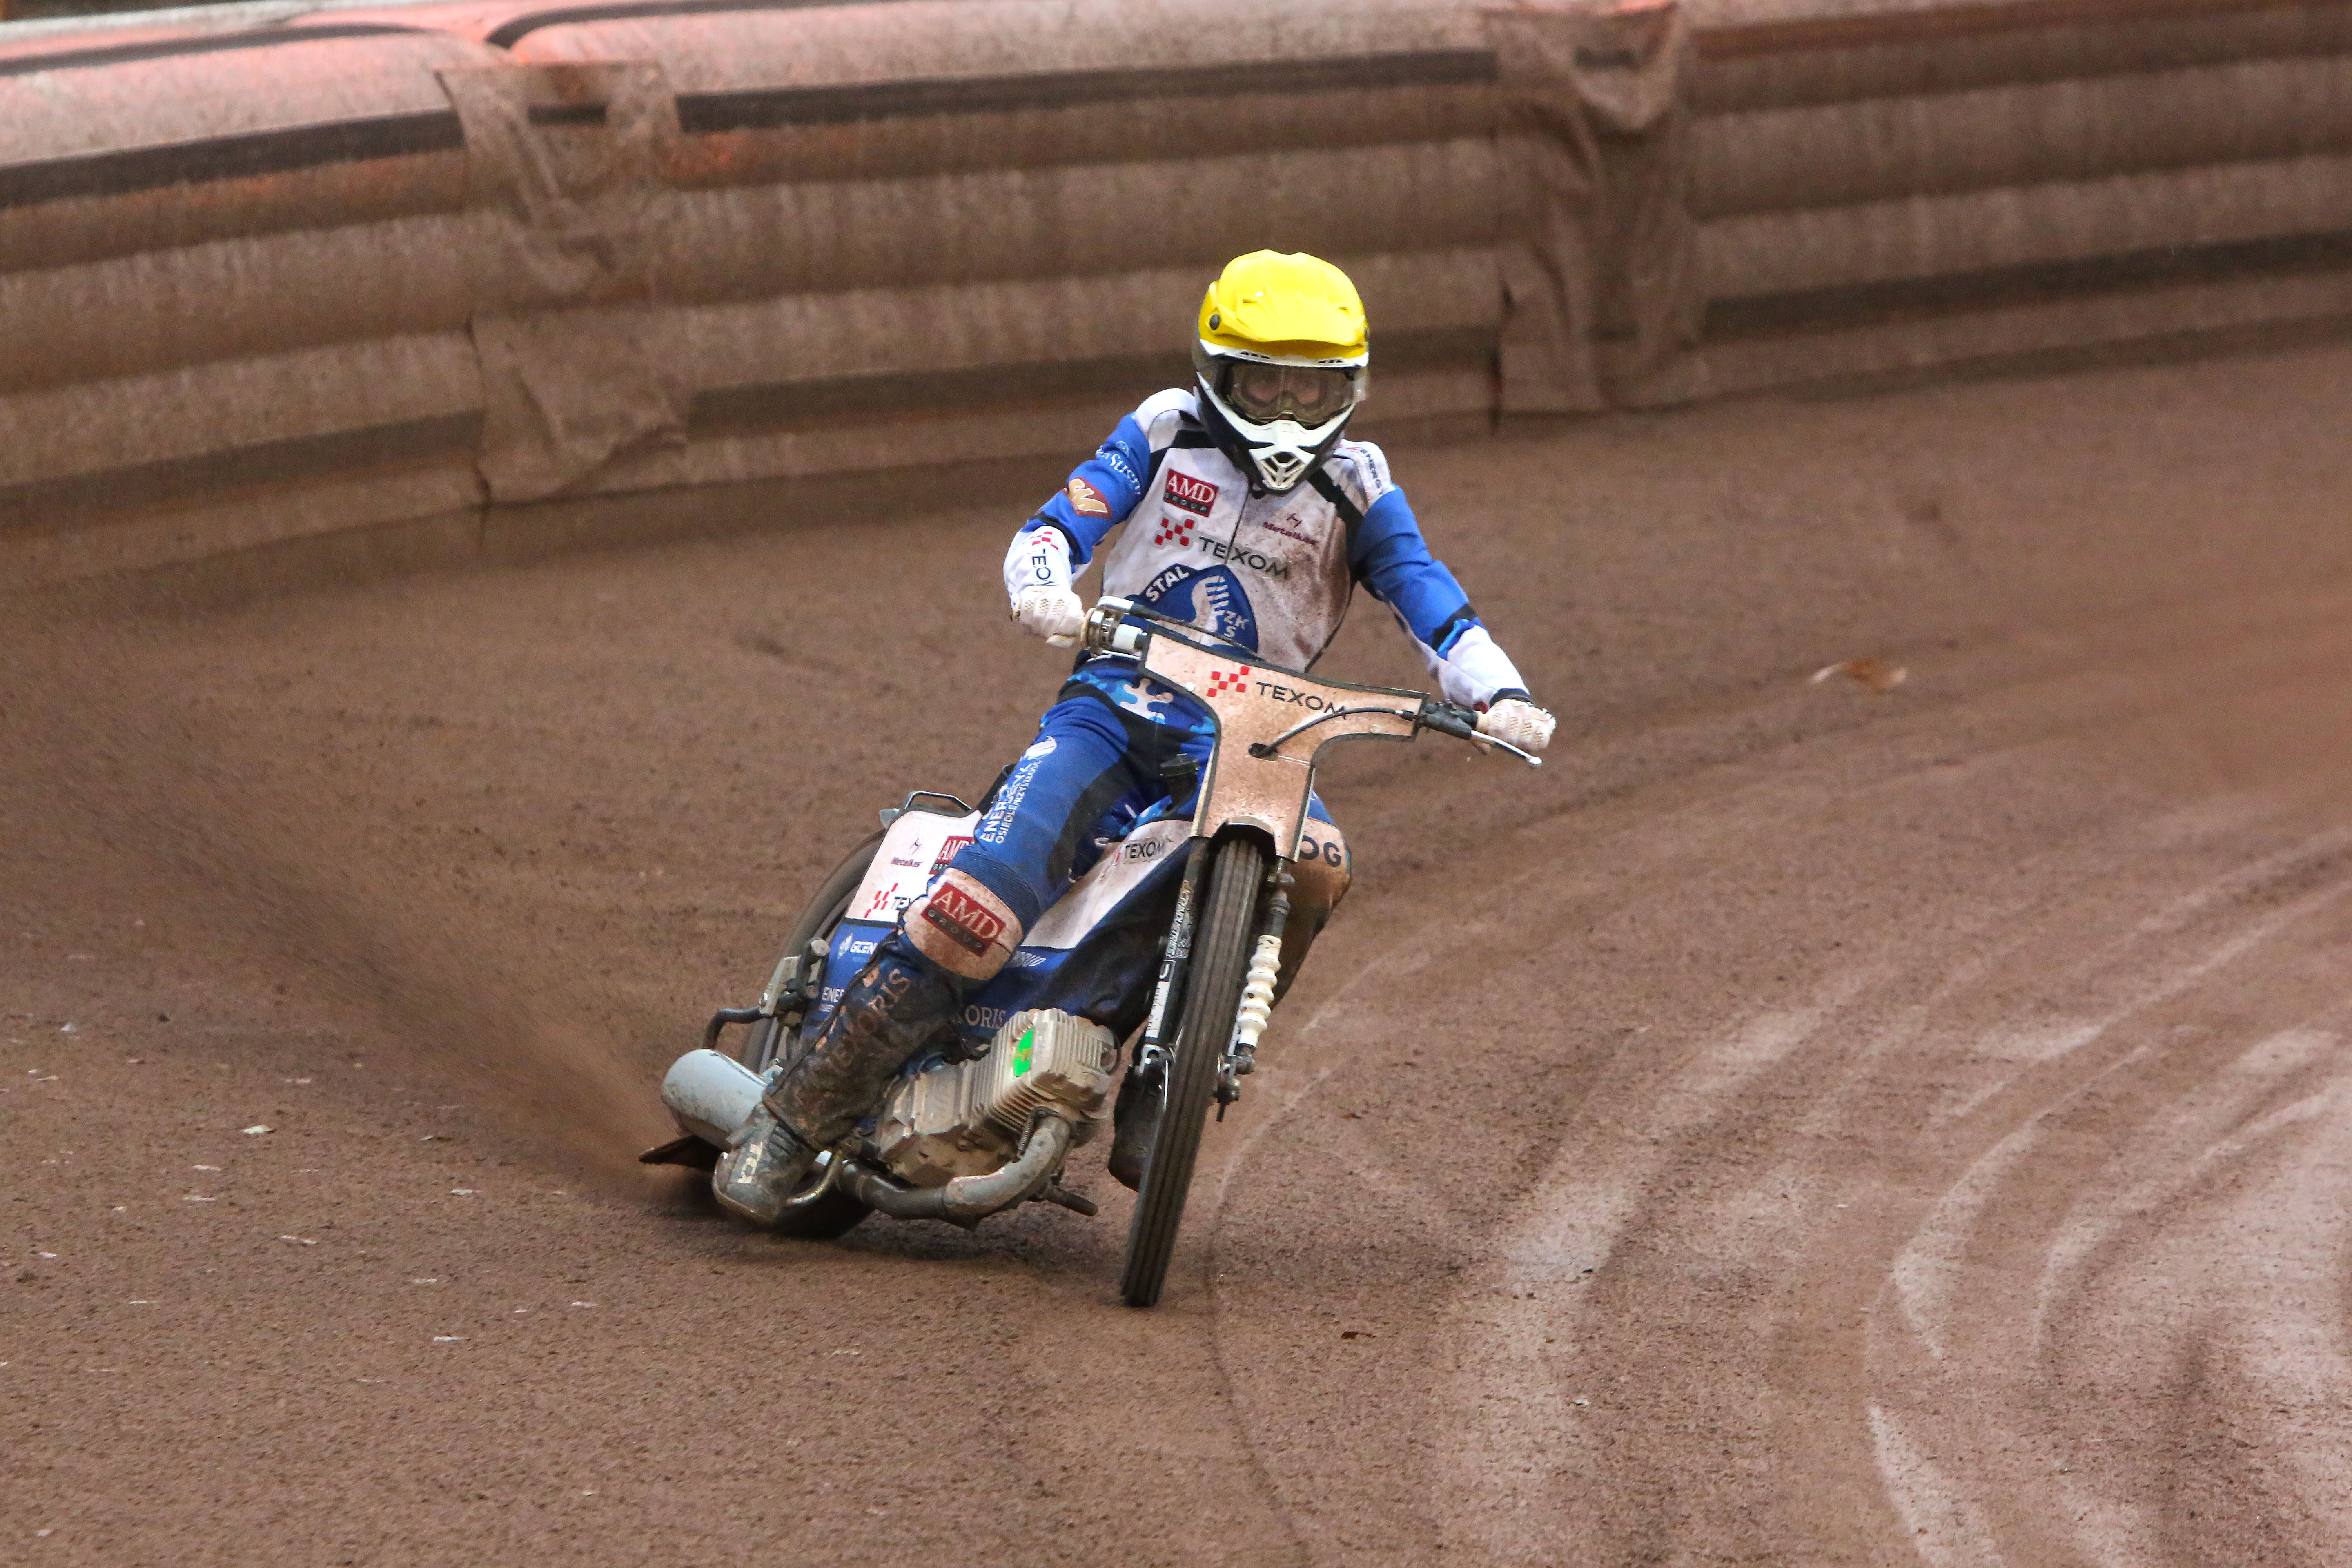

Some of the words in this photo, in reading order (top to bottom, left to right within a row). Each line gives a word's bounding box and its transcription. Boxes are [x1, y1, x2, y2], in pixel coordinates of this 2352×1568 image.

[1168, 474, 1215, 503] AMD
[1199, 535, 1289, 580] TEXOM
[1145, 566, 1189, 603] STAL
[1256, 681, 1347, 720] TEXOM
[1125, 841, 1164, 859] TEXOM
[927, 909, 983, 948] GROUP
[933, 890, 999, 939] AMD
